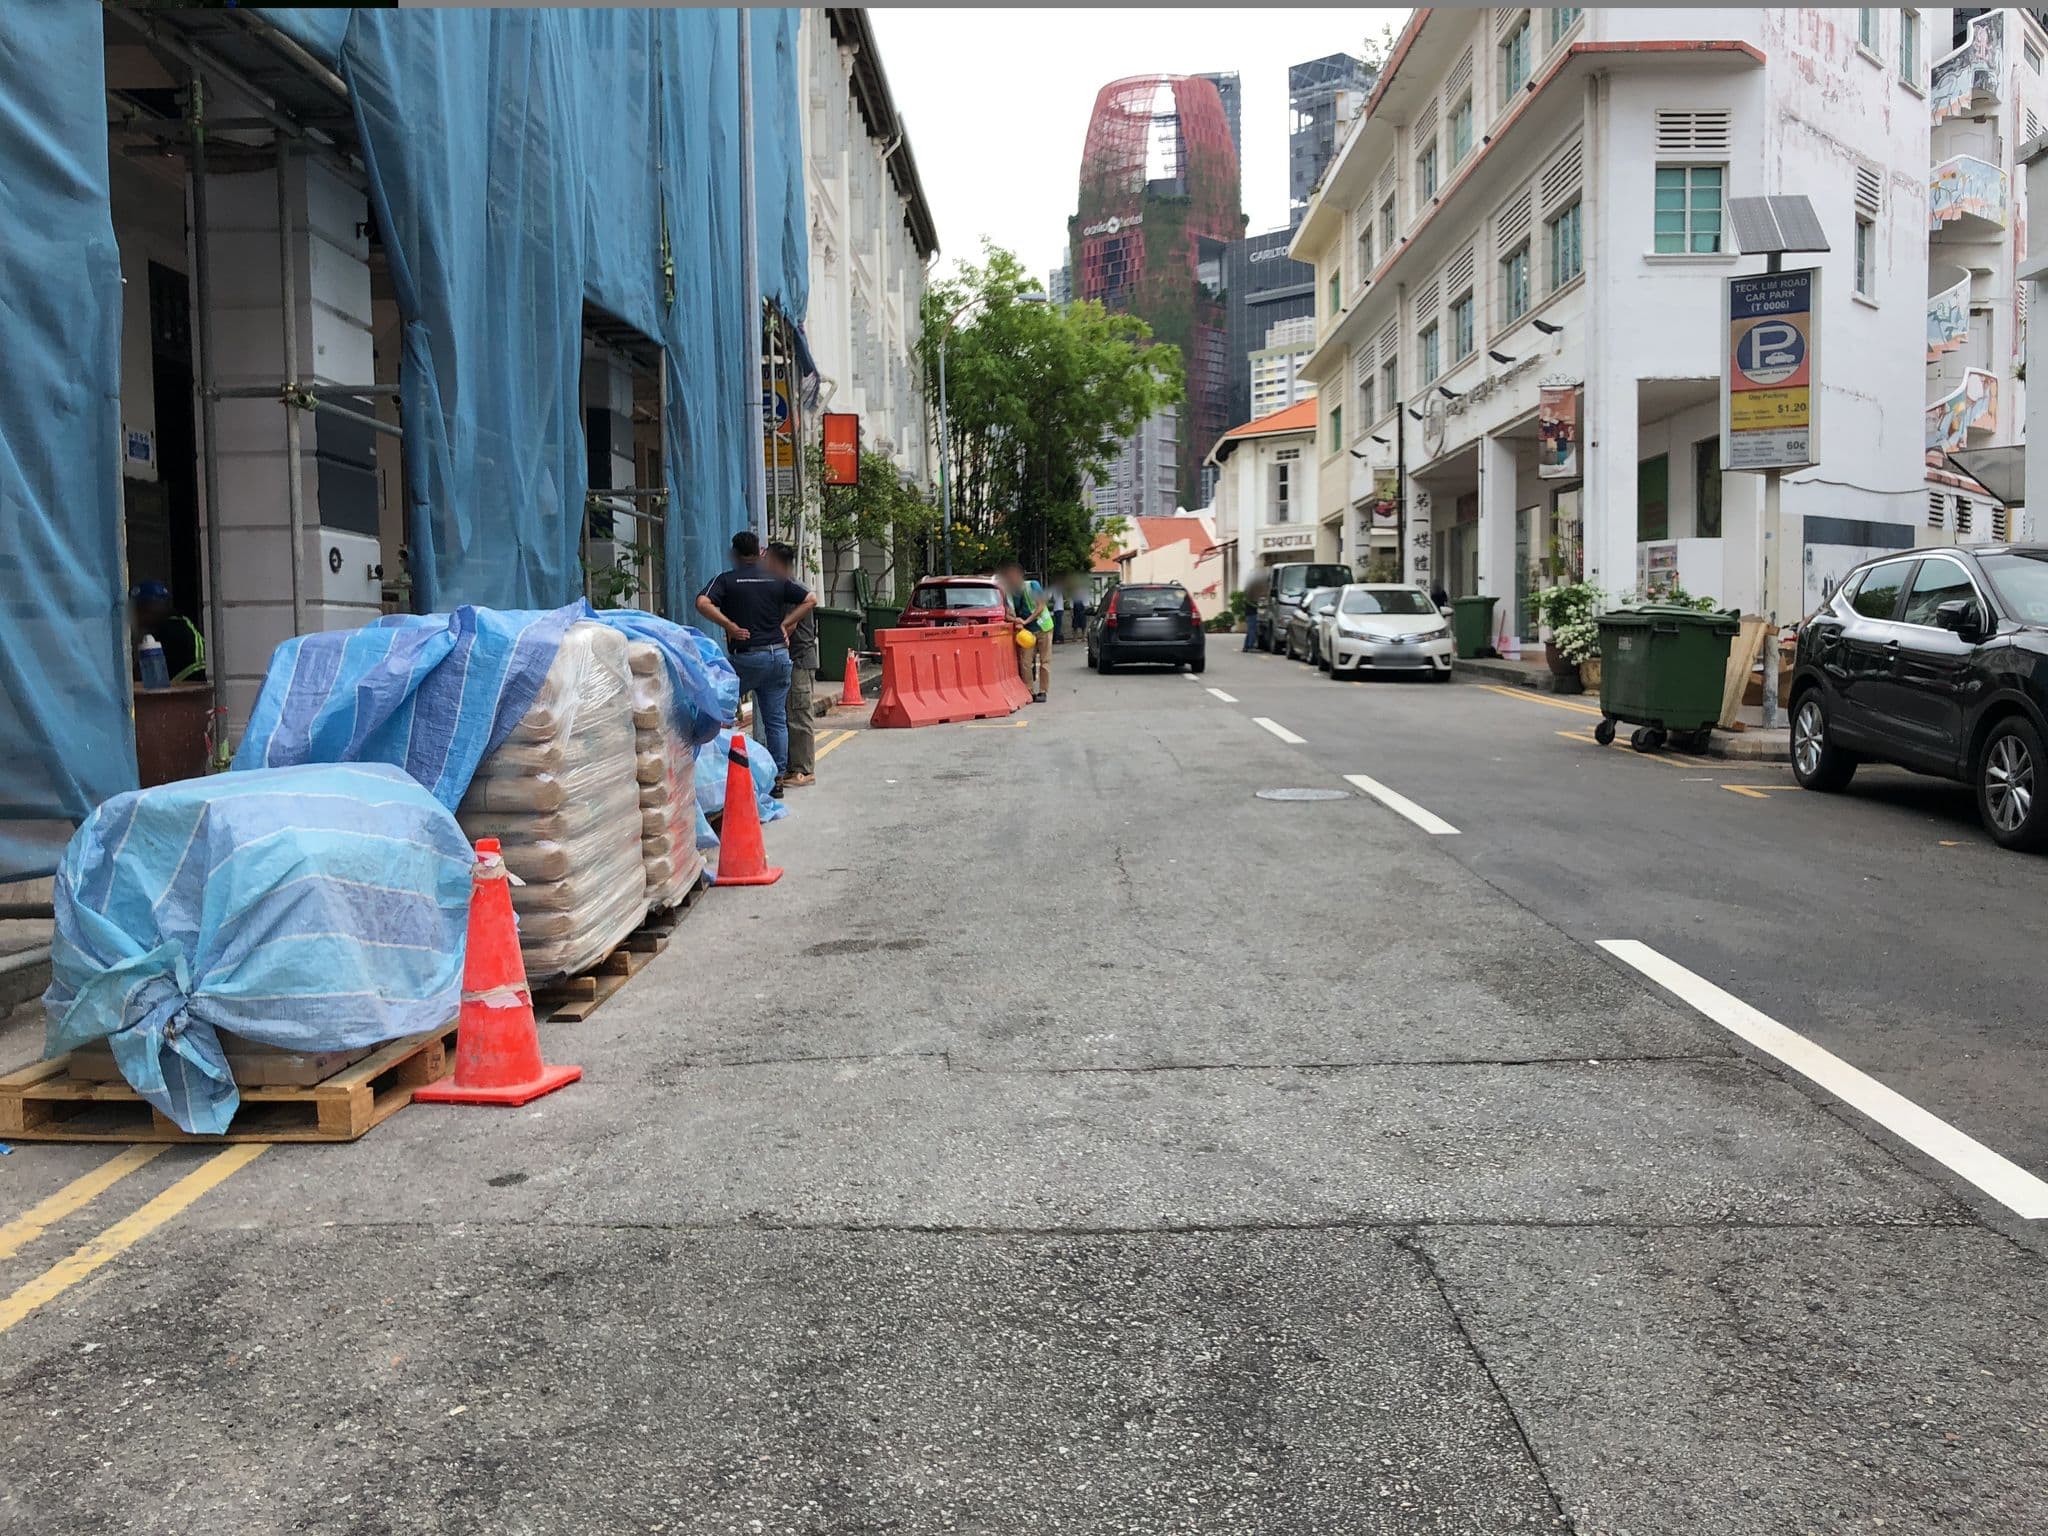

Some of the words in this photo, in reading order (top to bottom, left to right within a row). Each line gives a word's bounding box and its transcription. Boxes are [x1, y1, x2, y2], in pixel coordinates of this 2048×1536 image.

[1249, 245, 1289, 262] CARLTO
[1735, 283, 1758, 293] TECK
[1761, 281, 1777, 290] LIM
[1780, 278, 1808, 288] ROAD
[1745, 292, 1766, 302] CAR
[1769, 289, 1796, 299] PARK
[1752, 325, 1797, 369] P
[1777, 402, 1807, 414] $1.20
